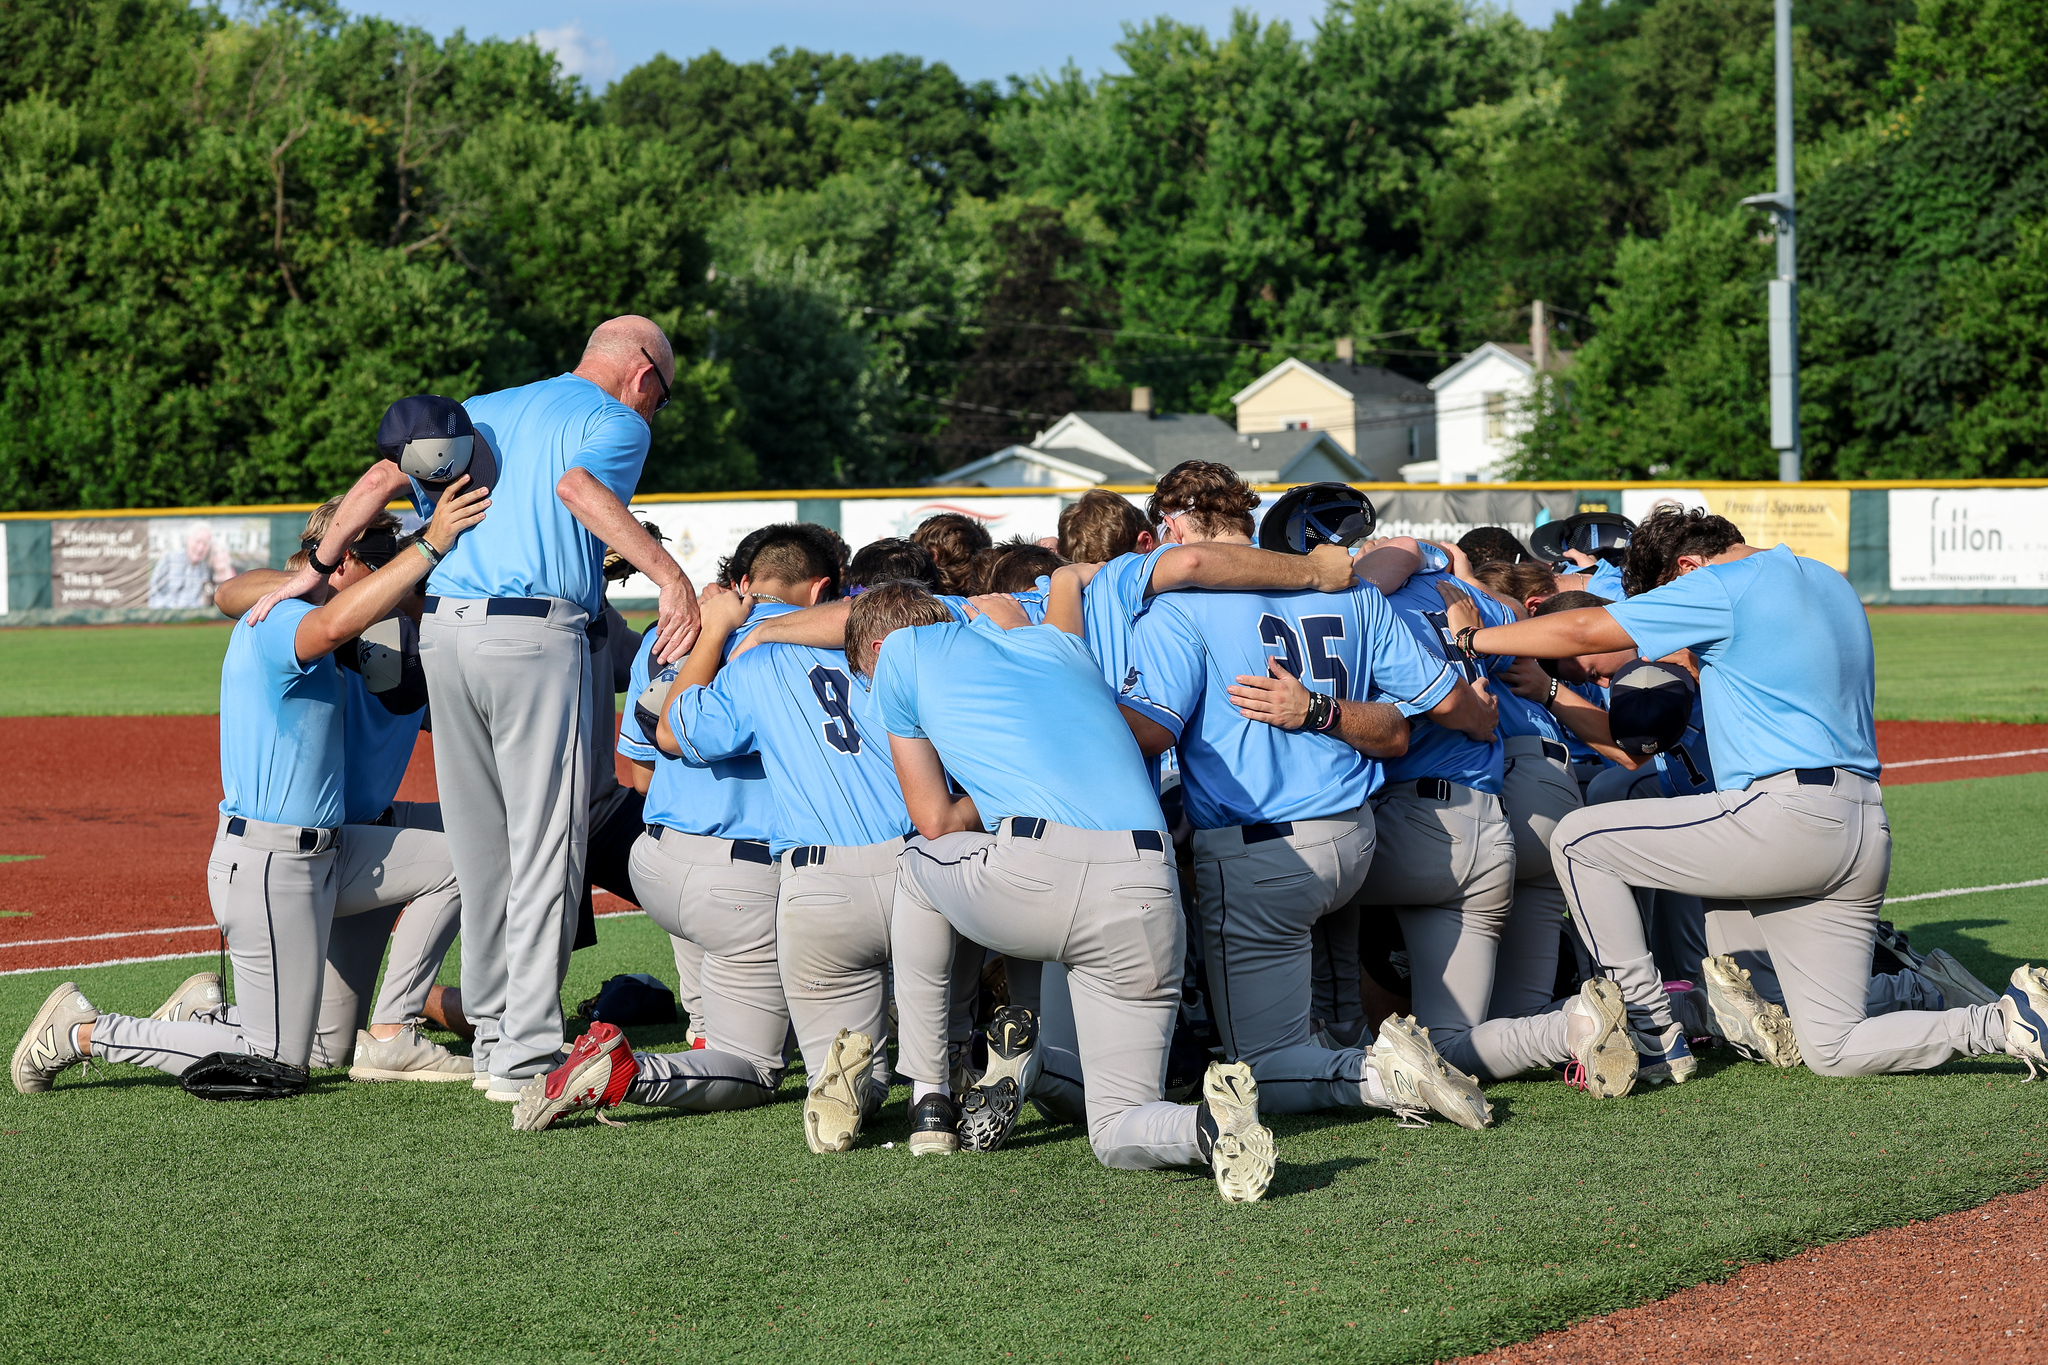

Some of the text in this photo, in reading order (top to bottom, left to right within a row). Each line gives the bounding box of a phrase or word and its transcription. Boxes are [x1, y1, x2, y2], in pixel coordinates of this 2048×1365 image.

[1724, 499, 1827, 517] Proud Sponsor
[61, 530, 133, 546] Thinking of
[61, 544, 142, 560] senior living?
[61, 571, 104, 586] This is
[61, 587, 122, 603] your sign.
[808, 663, 863, 756] 9
